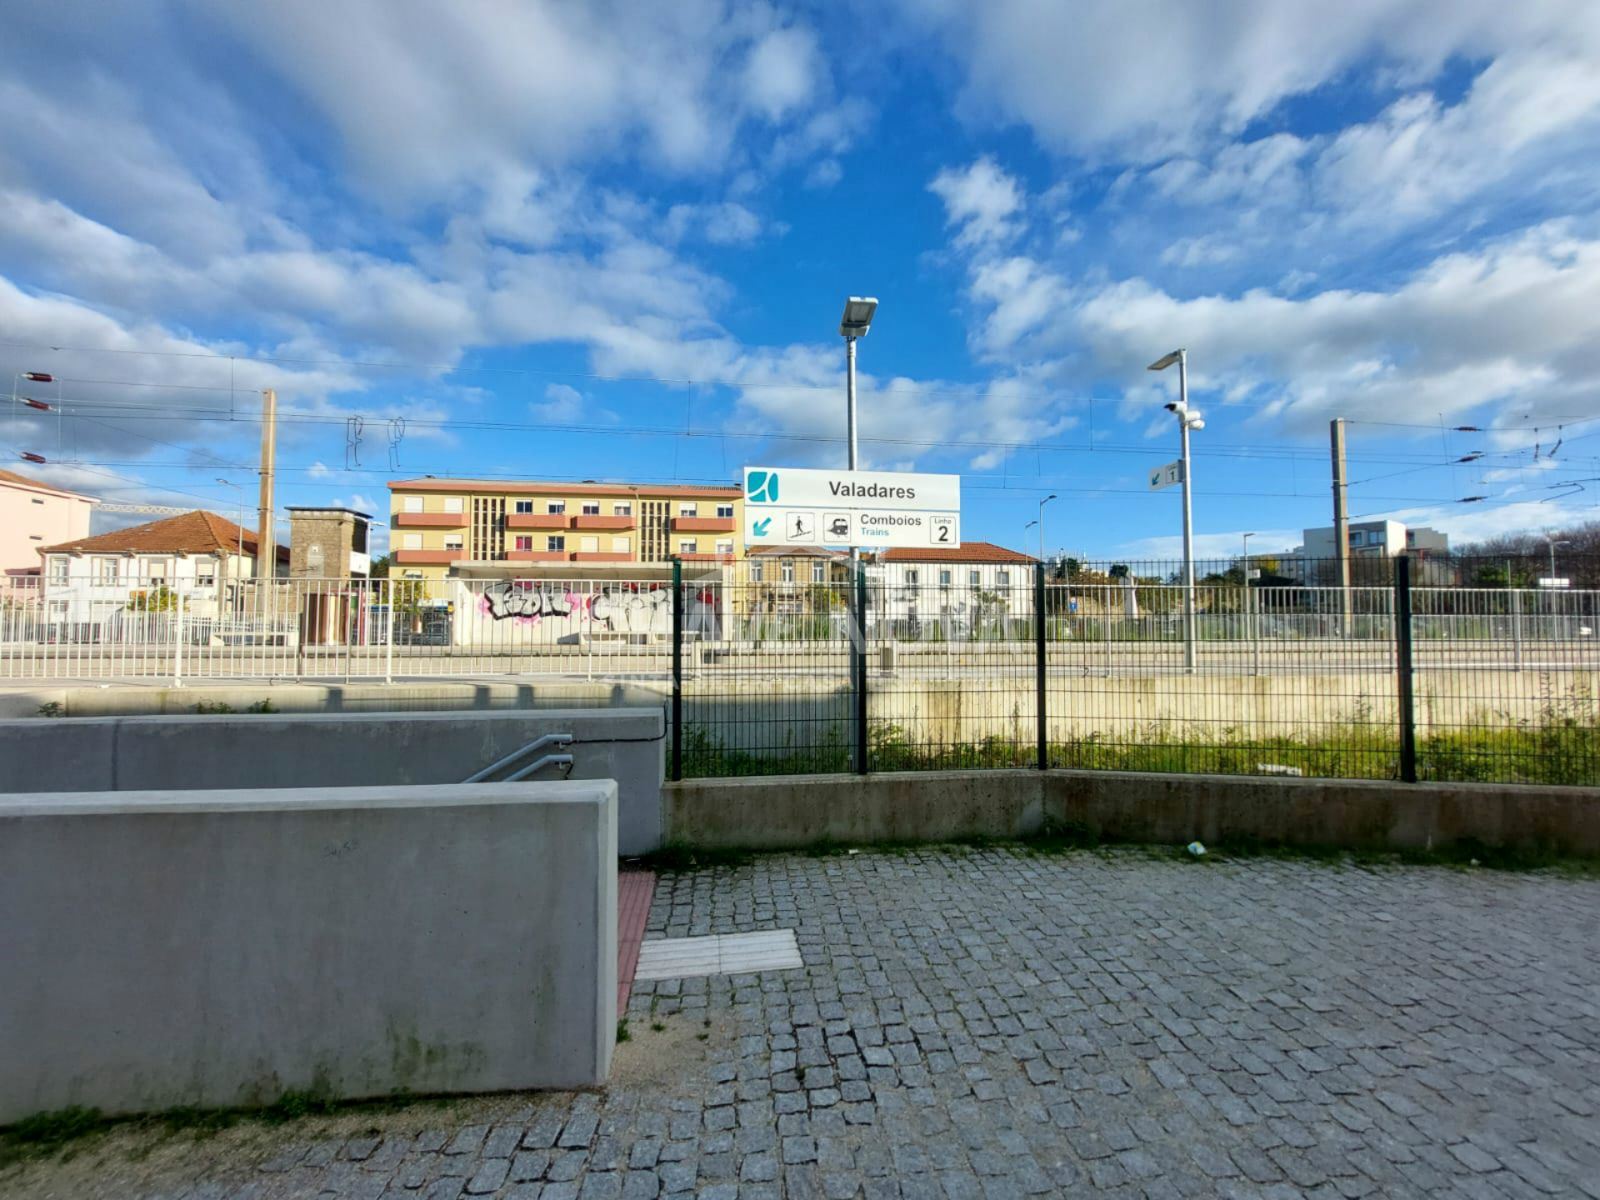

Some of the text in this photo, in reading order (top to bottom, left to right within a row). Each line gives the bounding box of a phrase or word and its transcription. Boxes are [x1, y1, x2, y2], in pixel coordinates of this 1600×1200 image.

[828, 481, 916, 499] Valadares
[860, 513, 922, 526] Comboios
[861, 527, 890, 536] Trains
[938, 525, 949, 542] 2
